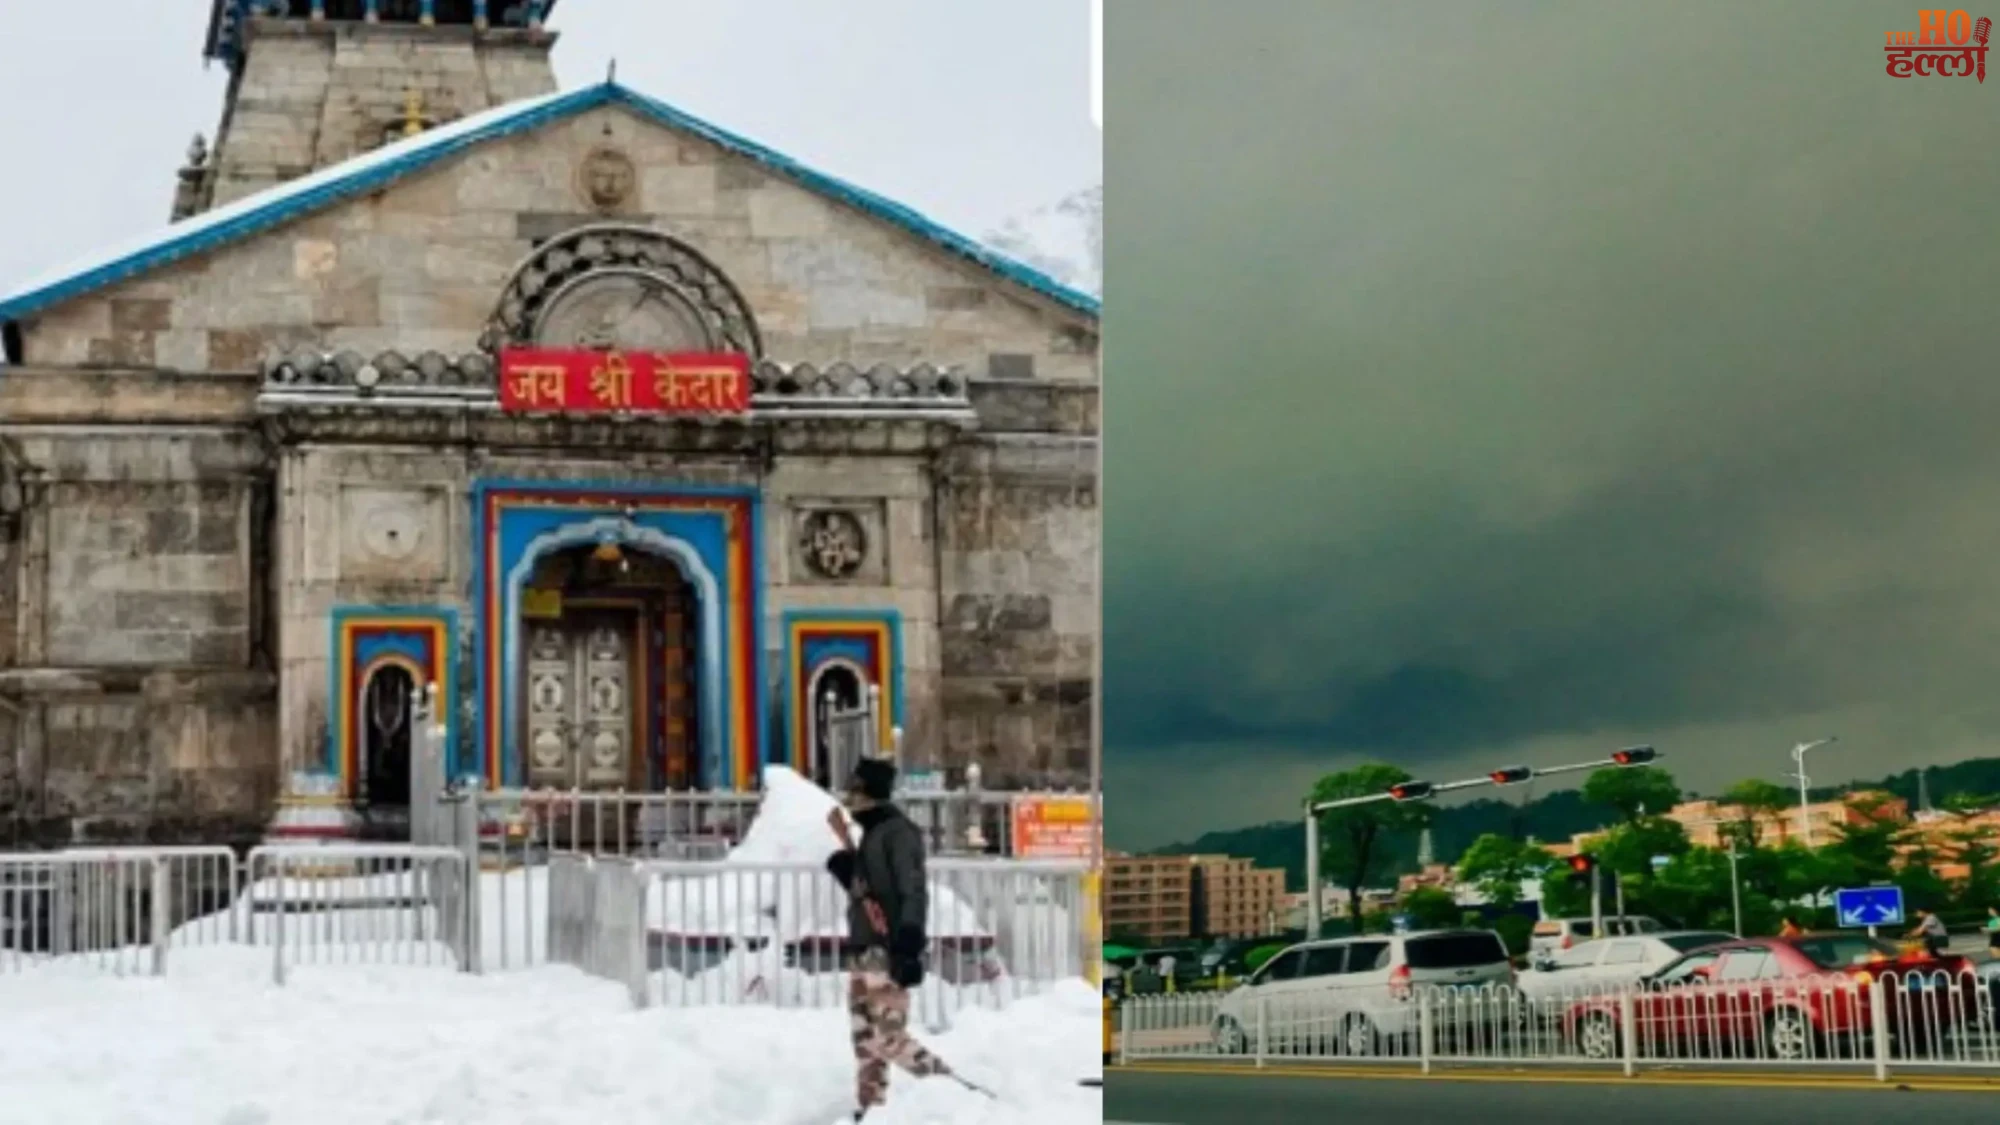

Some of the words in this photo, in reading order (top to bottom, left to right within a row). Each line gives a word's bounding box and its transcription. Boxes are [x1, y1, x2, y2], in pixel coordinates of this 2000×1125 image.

[507, 365, 567, 407] जय
[588, 350, 634, 407] श्री
[653, 353, 743, 414] केदार
